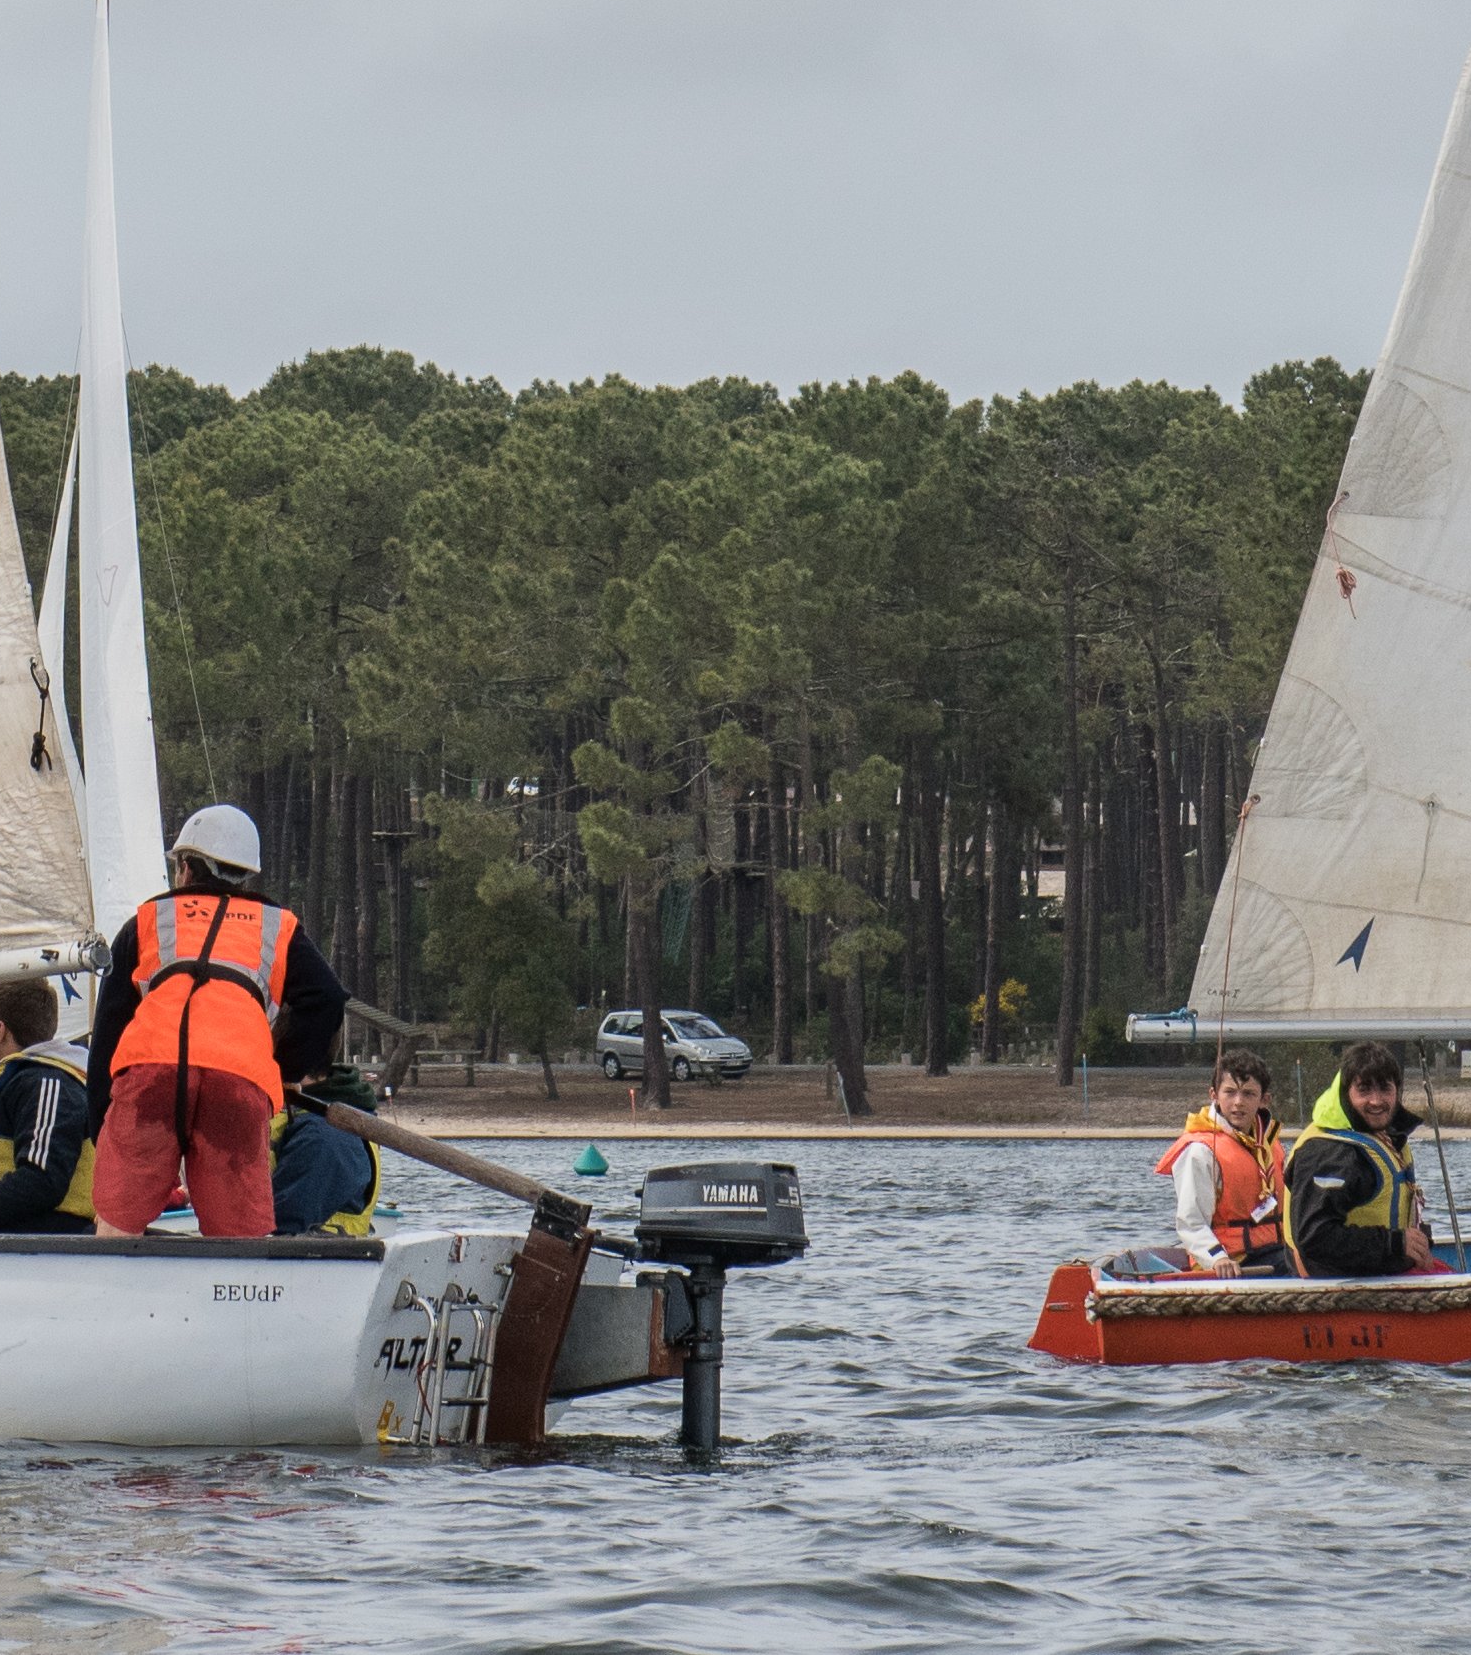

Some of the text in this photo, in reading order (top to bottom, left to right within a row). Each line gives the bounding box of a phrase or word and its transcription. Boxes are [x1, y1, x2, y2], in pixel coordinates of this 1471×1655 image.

[702, 1183, 759, 1203] YAMAHA
[787, 1185, 799, 1205] 5
[213, 1284, 285, 1302] EEUdF
